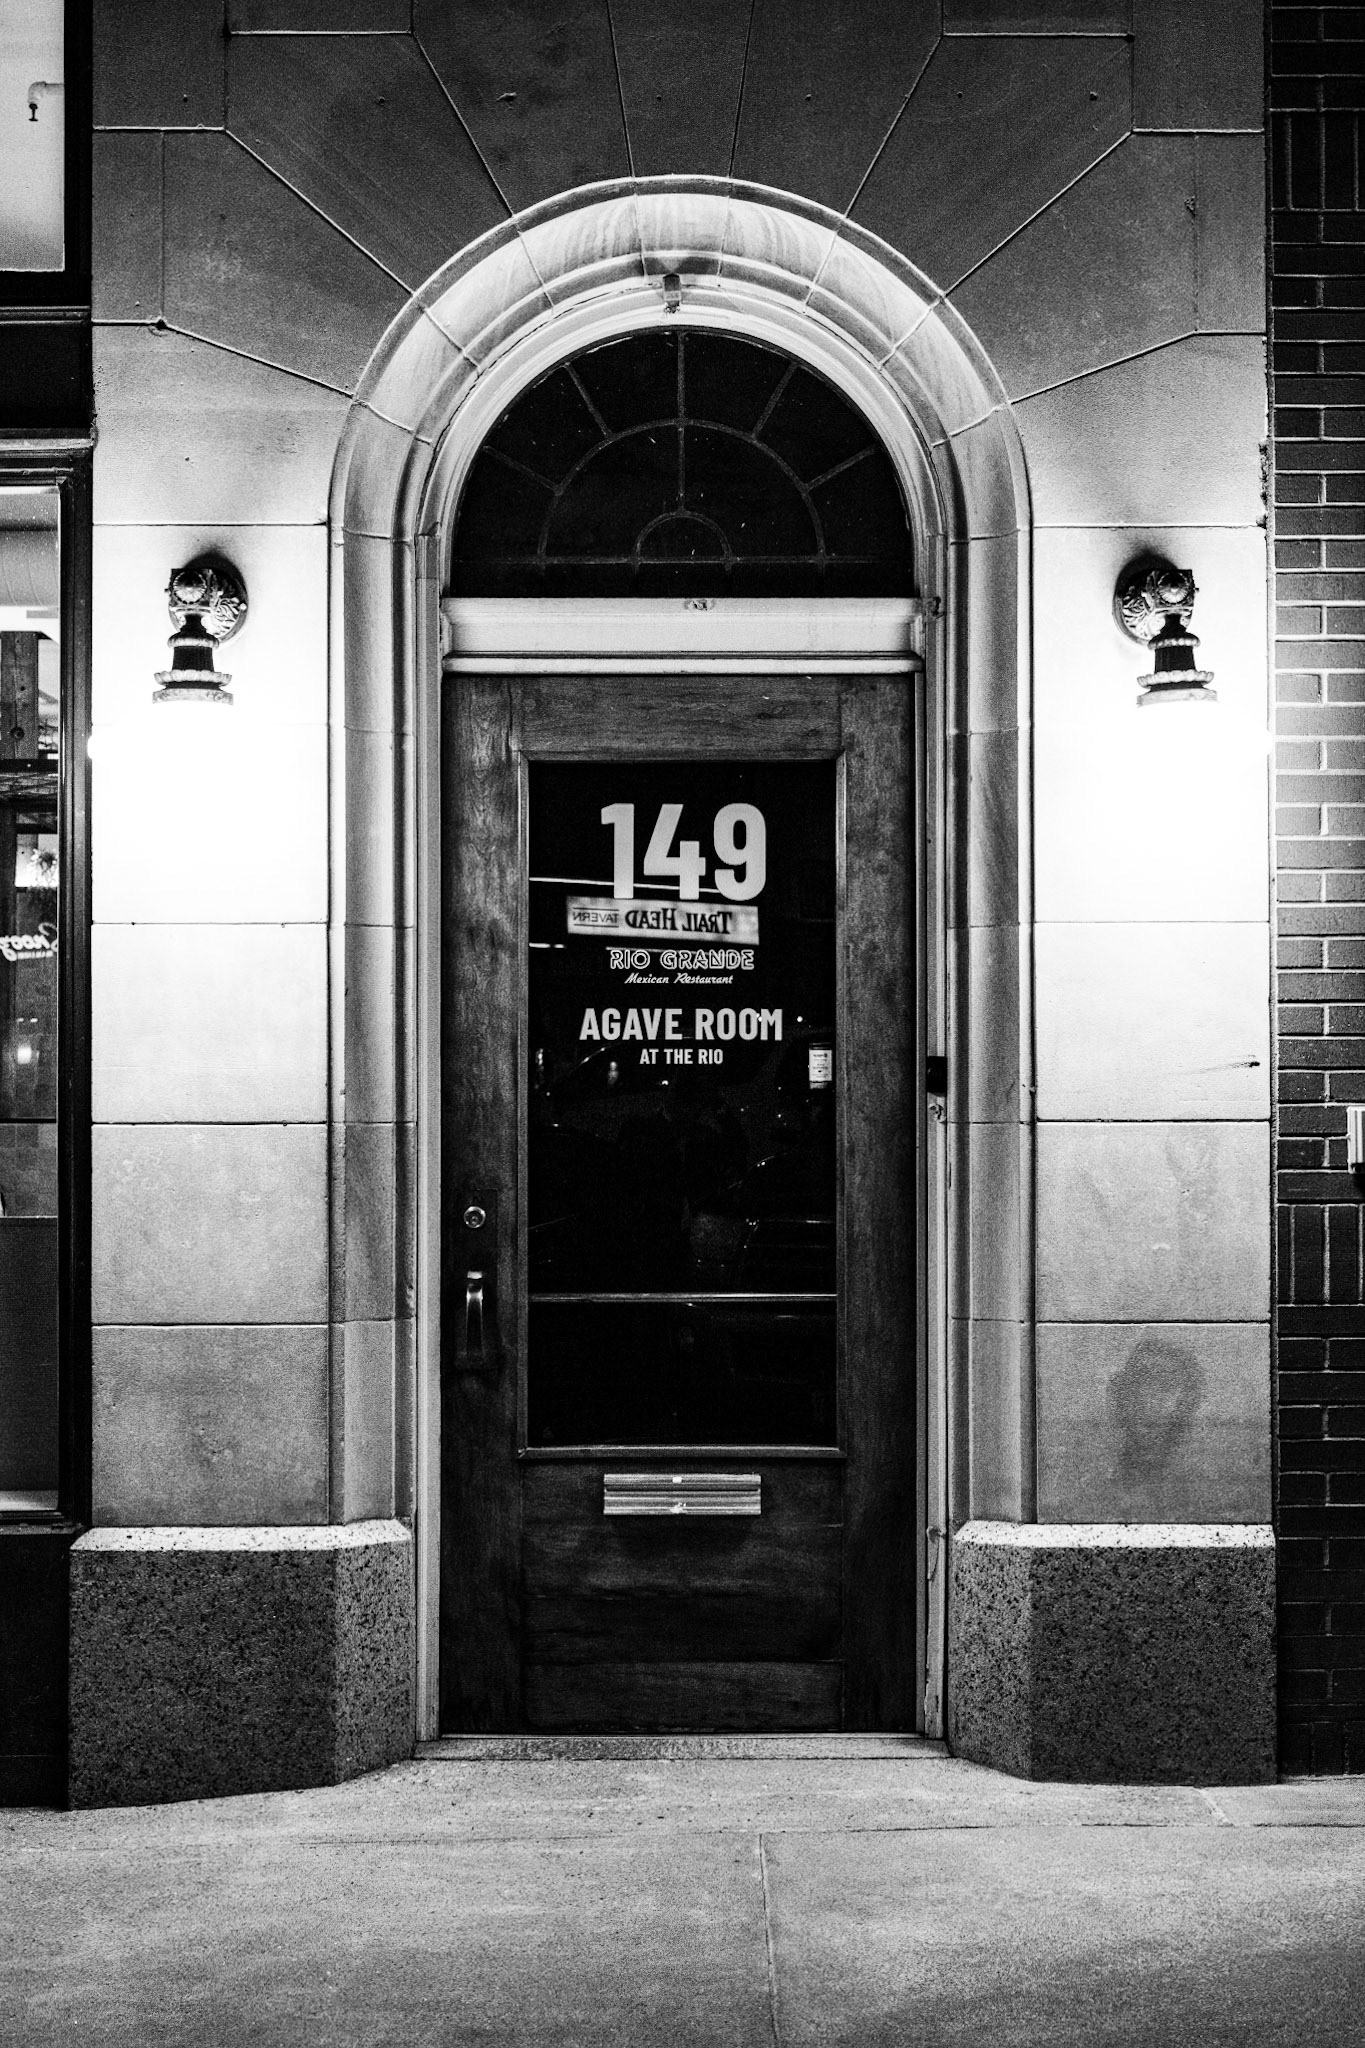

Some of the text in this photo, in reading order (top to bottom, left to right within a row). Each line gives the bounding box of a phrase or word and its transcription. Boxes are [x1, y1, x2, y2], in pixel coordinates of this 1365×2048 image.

[601, 803, 766, 901] 149
[610, 949, 755, 971] RIO GRANDE
[624, 972, 733, 985] Mexican Restaurant
[579, 1007, 783, 1041] AGAVE ROOM
[639, 1049, 723, 1065] AT THE RIO
